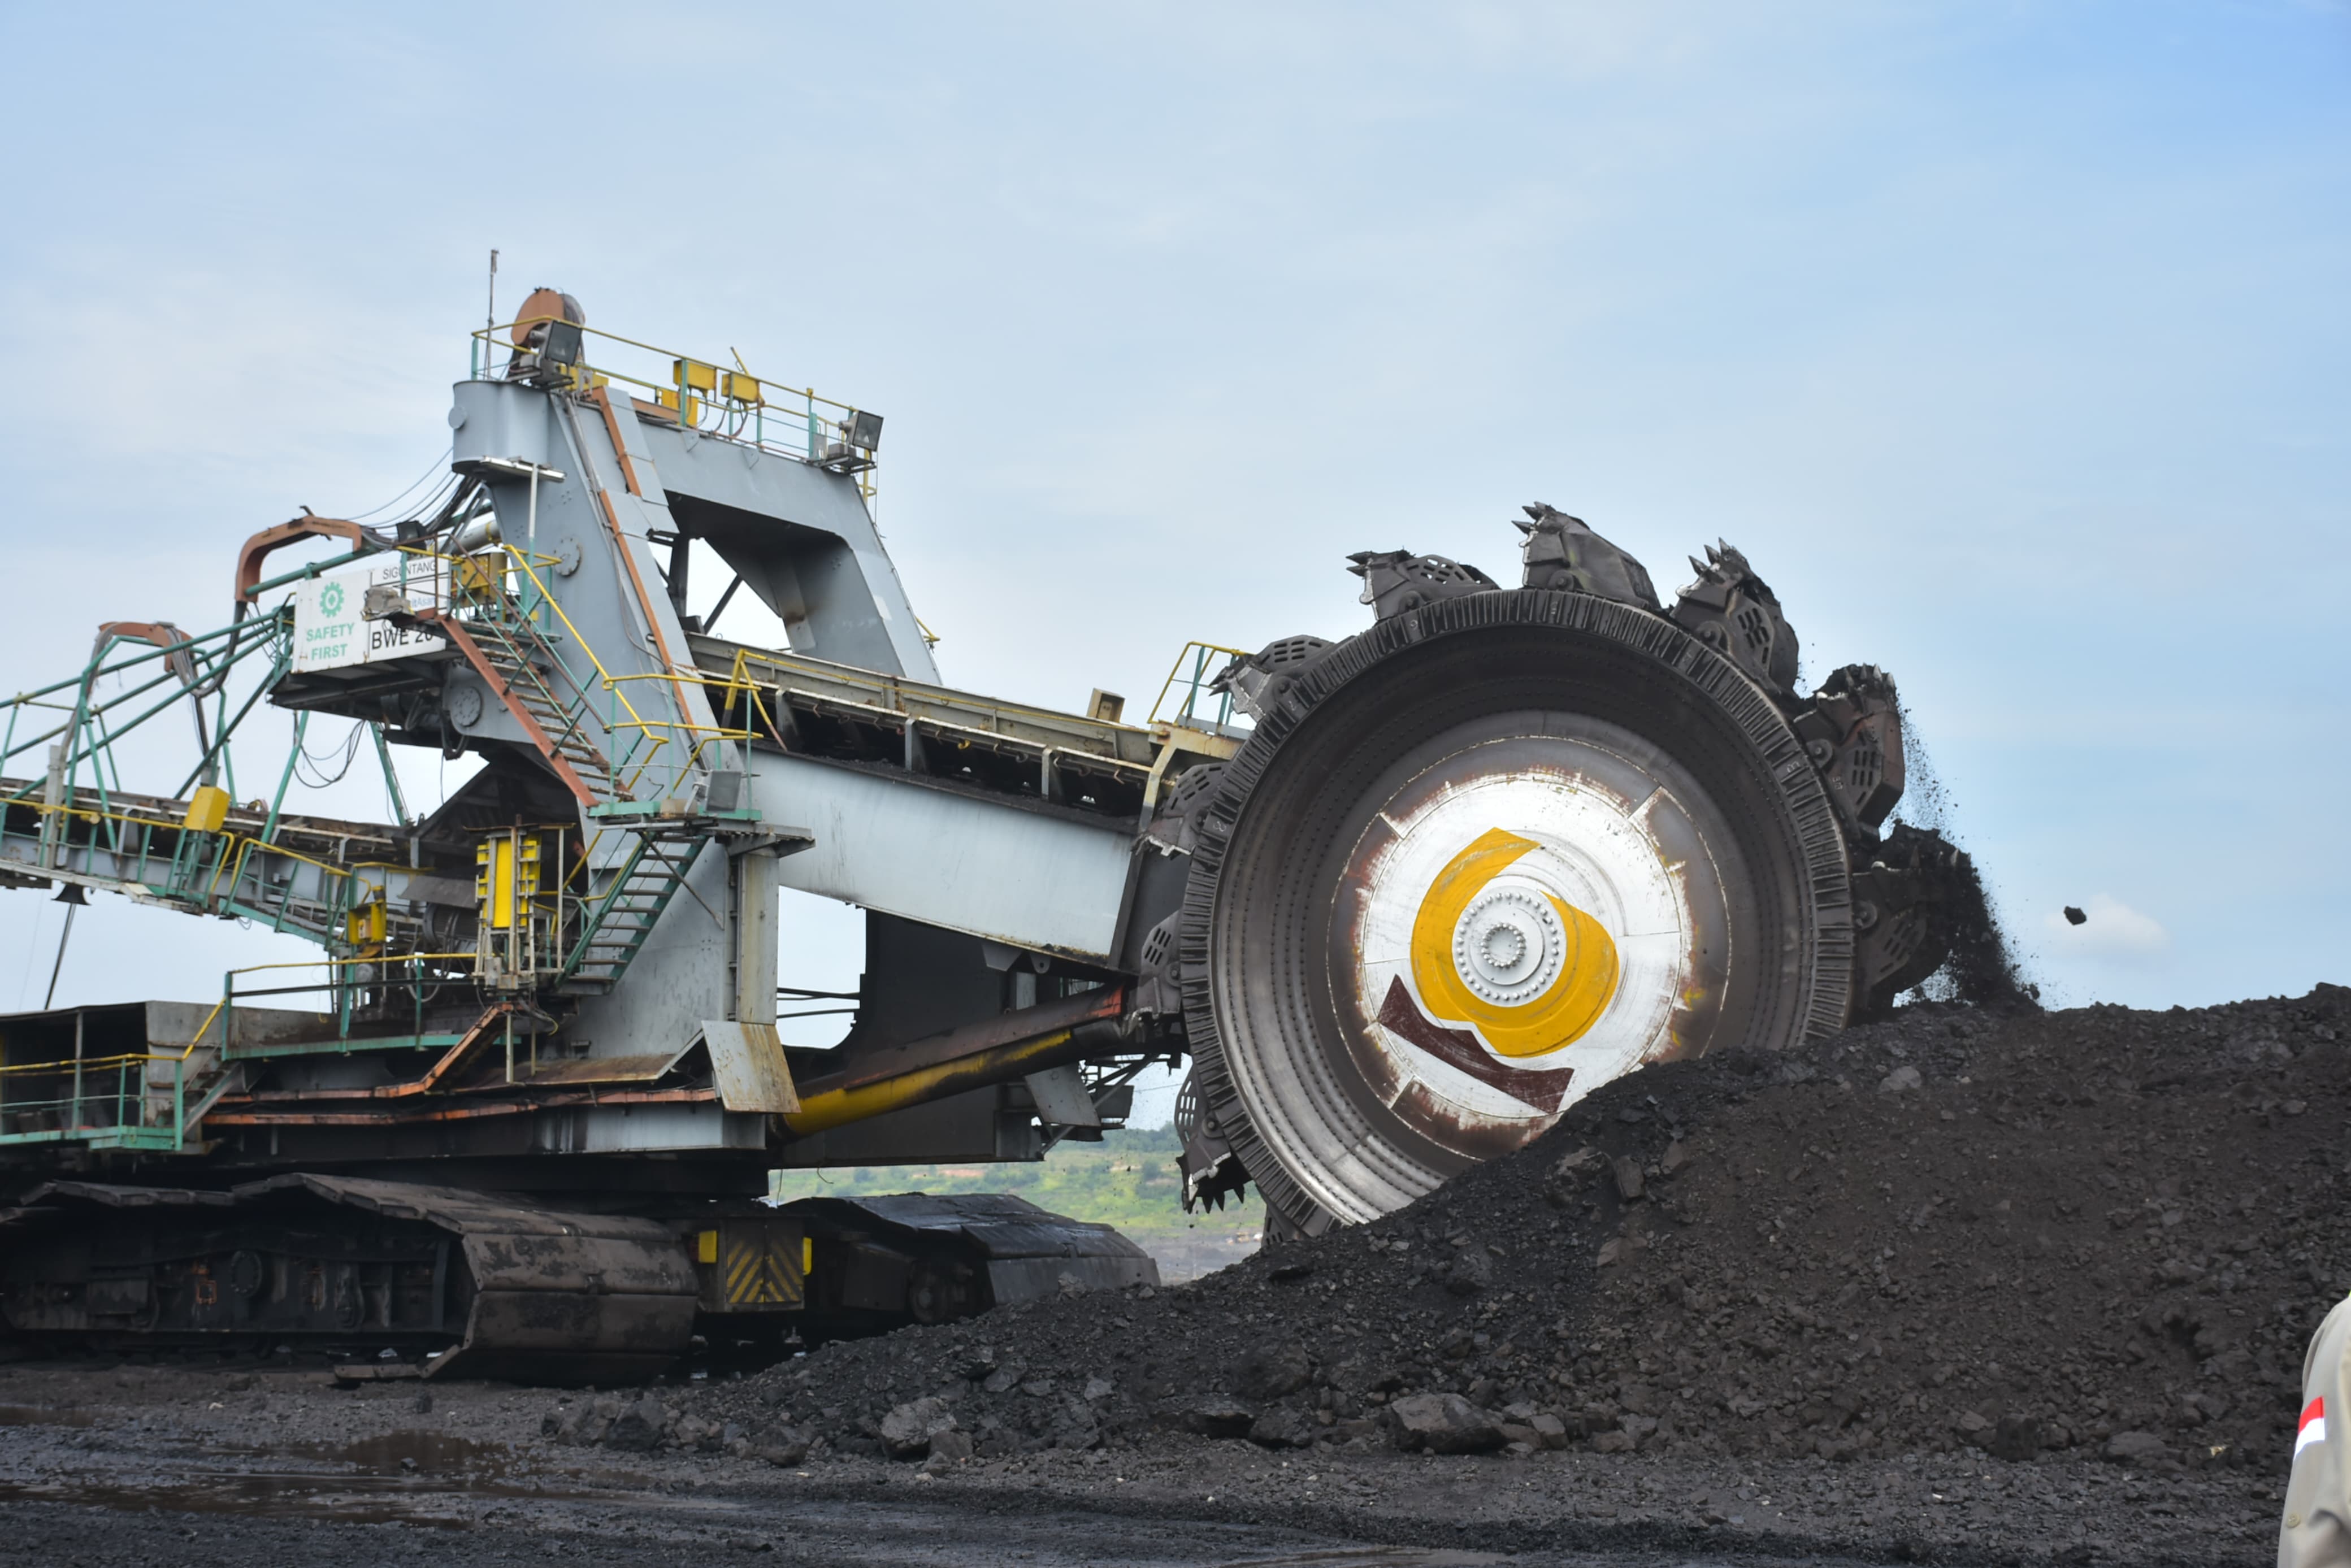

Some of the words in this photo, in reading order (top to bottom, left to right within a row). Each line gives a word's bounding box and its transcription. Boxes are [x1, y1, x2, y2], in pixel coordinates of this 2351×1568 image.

[383, 560, 435, 580] SIGNTANG
[306, 622, 355, 642] SAFETY
[372, 628, 409, 650] BWE
[311, 643, 348, 660] FIRST
[1212, 820, 1227, 832] 8
